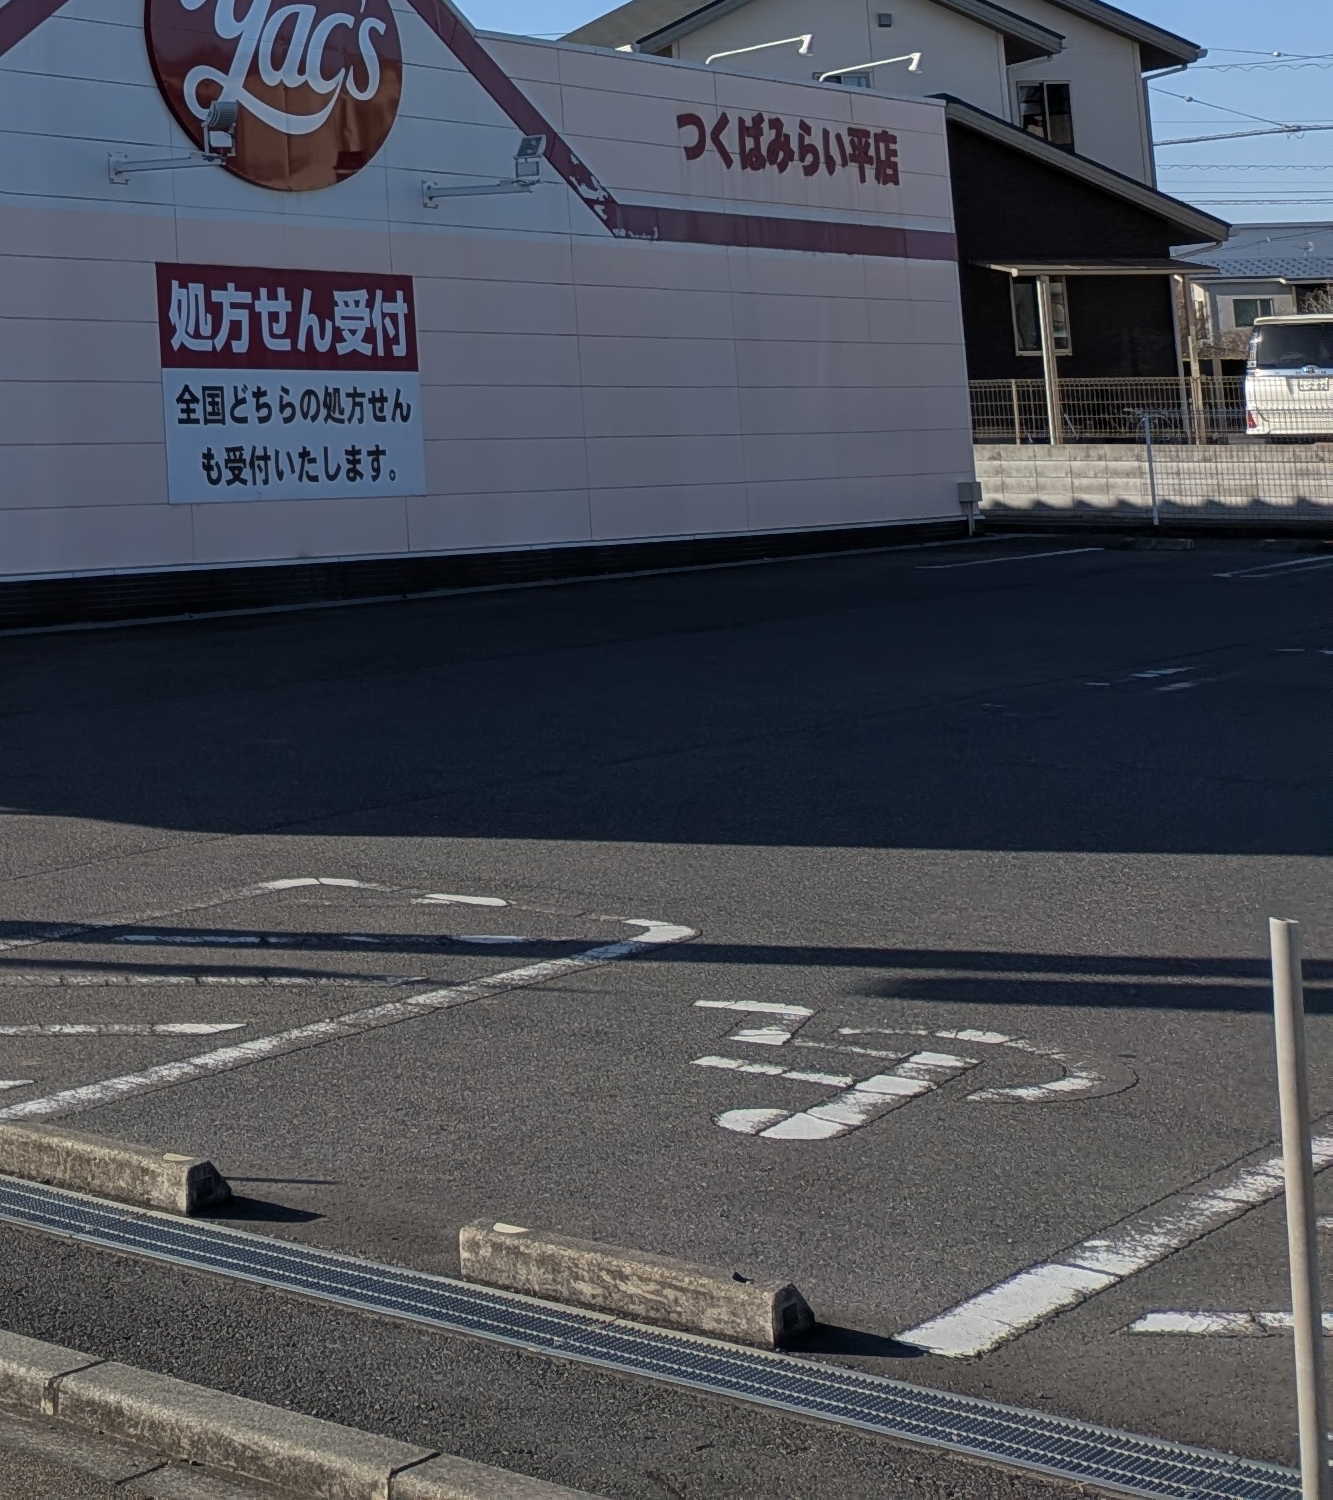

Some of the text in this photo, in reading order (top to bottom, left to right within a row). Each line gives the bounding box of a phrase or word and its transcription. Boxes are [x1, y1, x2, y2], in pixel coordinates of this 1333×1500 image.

[675, 112, 900, 187] つくばみらい平店
[168, 280, 409, 358] 処方せん受付
[175, 384, 412, 427] 全国どちらの処方せん
[202, 443, 399, 488] も受付いたします。
